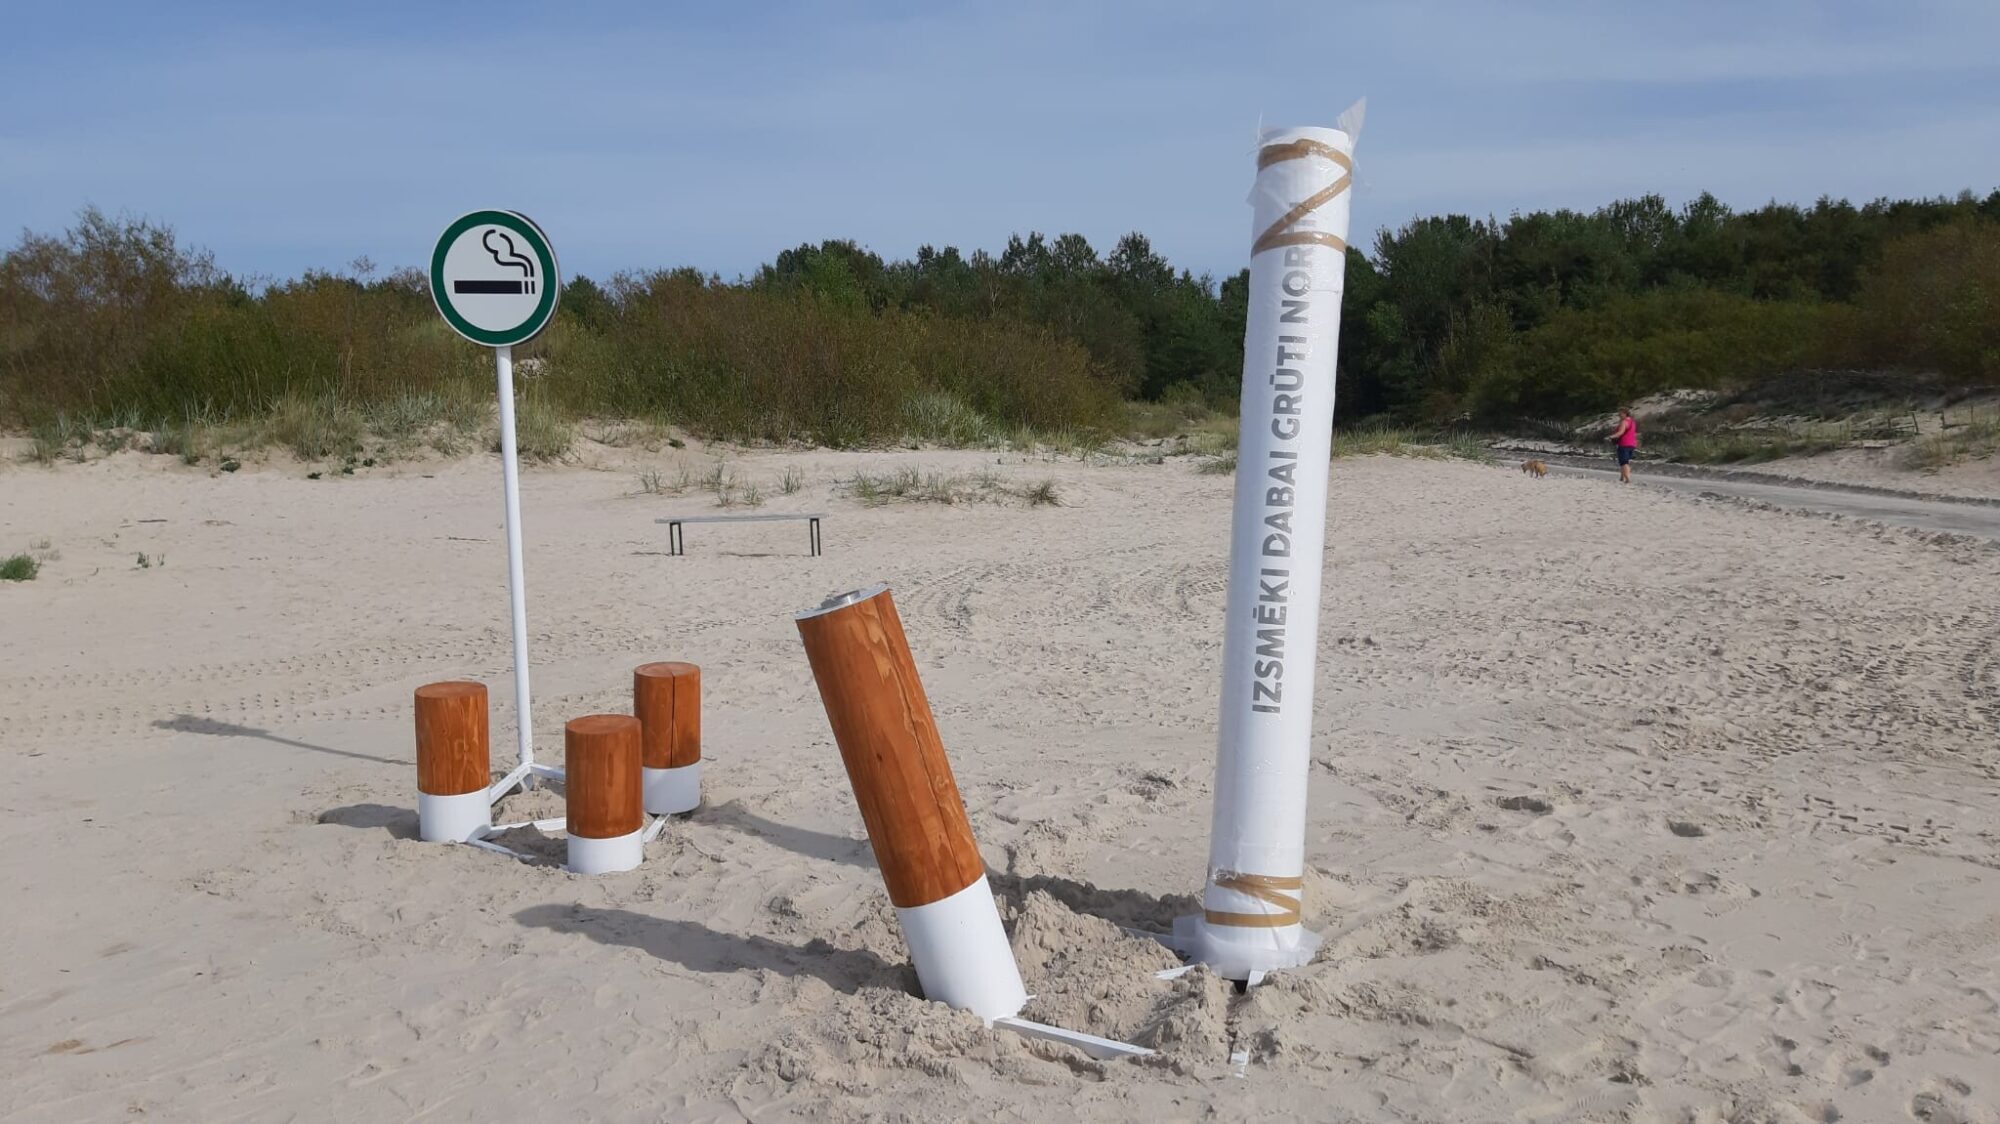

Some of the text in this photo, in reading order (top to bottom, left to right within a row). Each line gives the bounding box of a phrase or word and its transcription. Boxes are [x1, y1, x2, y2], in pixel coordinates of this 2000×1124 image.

[1270, 335, 1308, 441] GRŪTI
[1262, 450, 1299, 558] DABAI
[1252, 568, 1291, 714] IZSMĒKI
